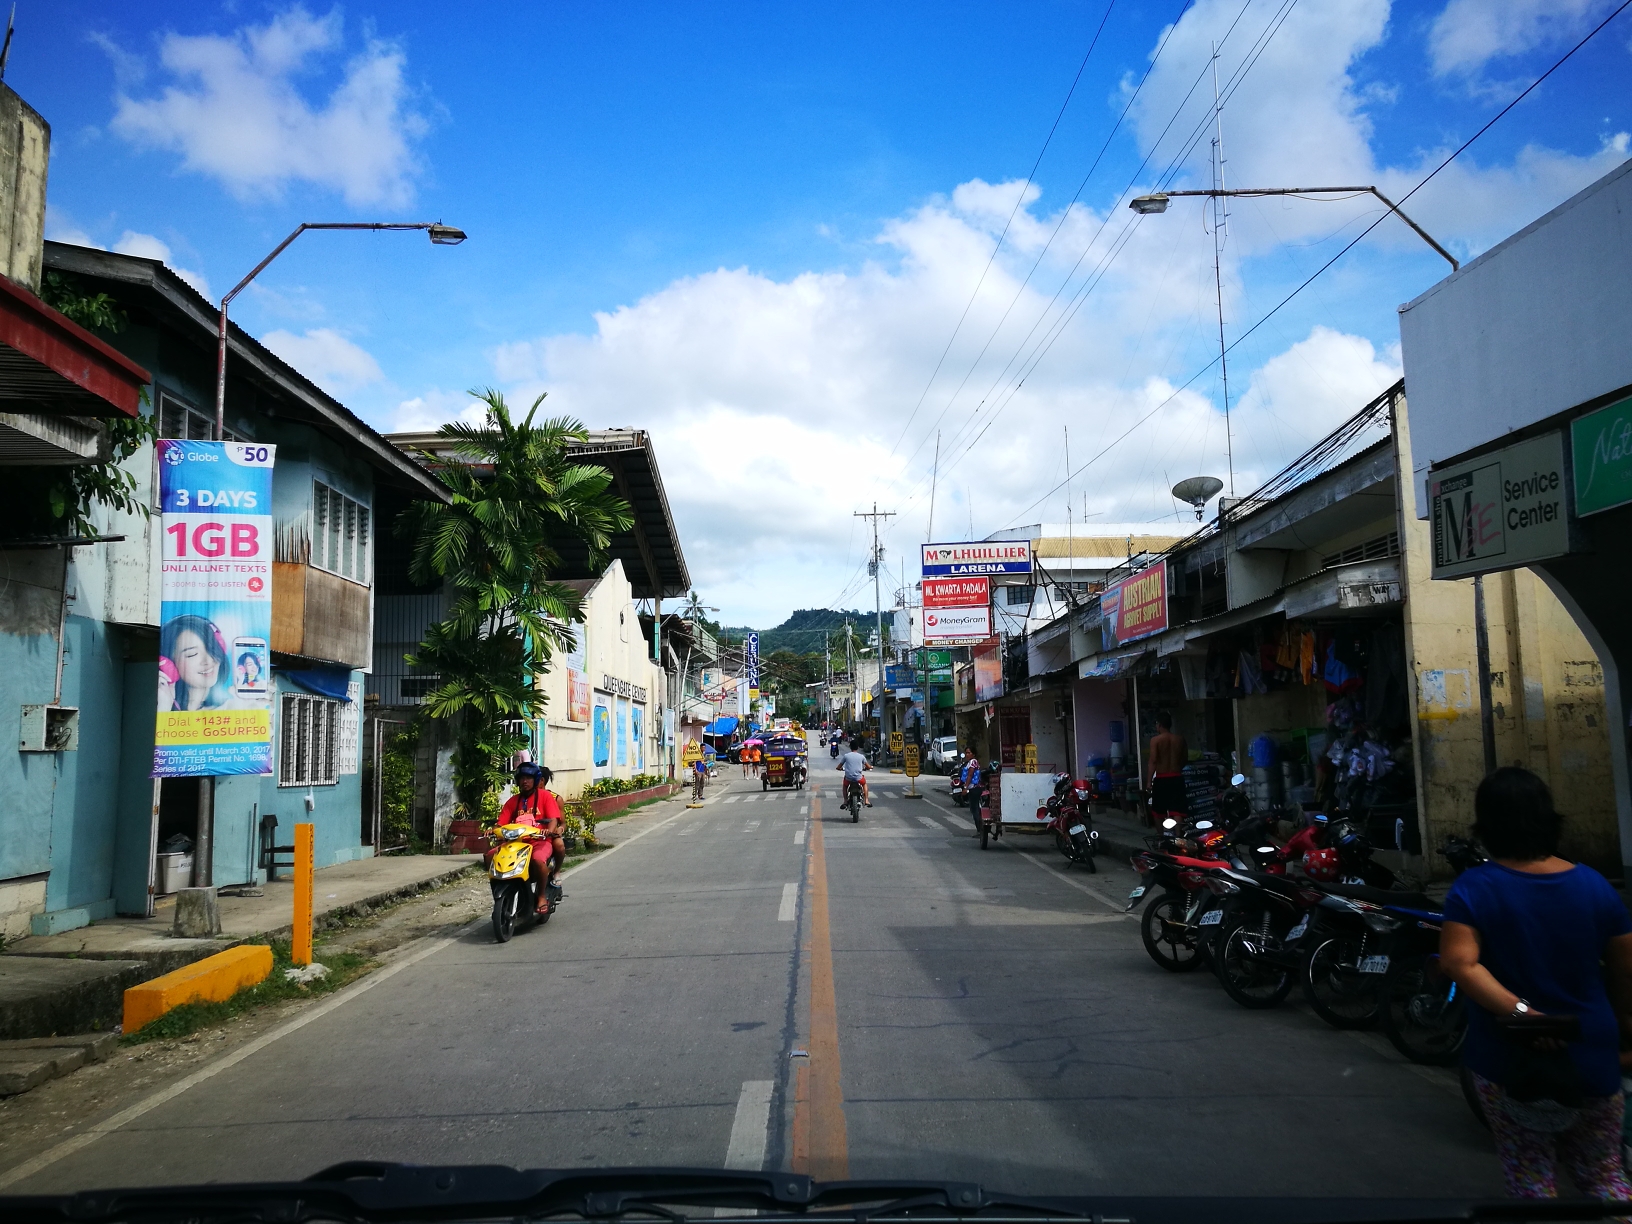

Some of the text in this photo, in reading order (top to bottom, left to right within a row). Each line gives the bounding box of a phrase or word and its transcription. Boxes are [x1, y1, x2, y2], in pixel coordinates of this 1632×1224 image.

[188, 452, 219, 462] Globe
[1582, 418, 1632, 498] Nat
[1504, 471, 1559, 502] Service
[176, 489, 257, 508] 3 DAYS
[1507, 500, 1559, 530] Center
[166, 522, 260, 558] 1GB
[1434, 516, 1444, 566] marikina
[953, 547, 1027, 560] LHUILLIER
[162, 564, 267, 573] UNLI ALLNET TEXTS
[951, 563, 1006, 574] LARENA
[935, 583, 961, 596] KWARTA
[962, 582, 987, 594] PADALA
[1123, 571, 1162, 612] AUSTRIAN
[1142, 600, 1162, 622] SUPPLY
[940, 616, 986, 625] MoneyGram
[603, 674, 631, 698] QUEENGATE
[632, 684, 647, 702] CENTER
[168, 717, 191, 727] Dial
[235, 715, 256, 725] and
[156, 726, 267, 738] choose GoSURF50
[891, 733, 903, 742] NO
[154, 746, 271, 757] Promo valid until March 30, 2017
[906, 746, 918, 754] NO
[153, 757, 167, 765] Per
[168, 756, 206, 764] DTI-FTEB
[208, 755, 232, 763] Permit
[233, 754, 246, 762] No.
[153, 765, 176, 773] Series
[187, 764, 206, 772] 2017
